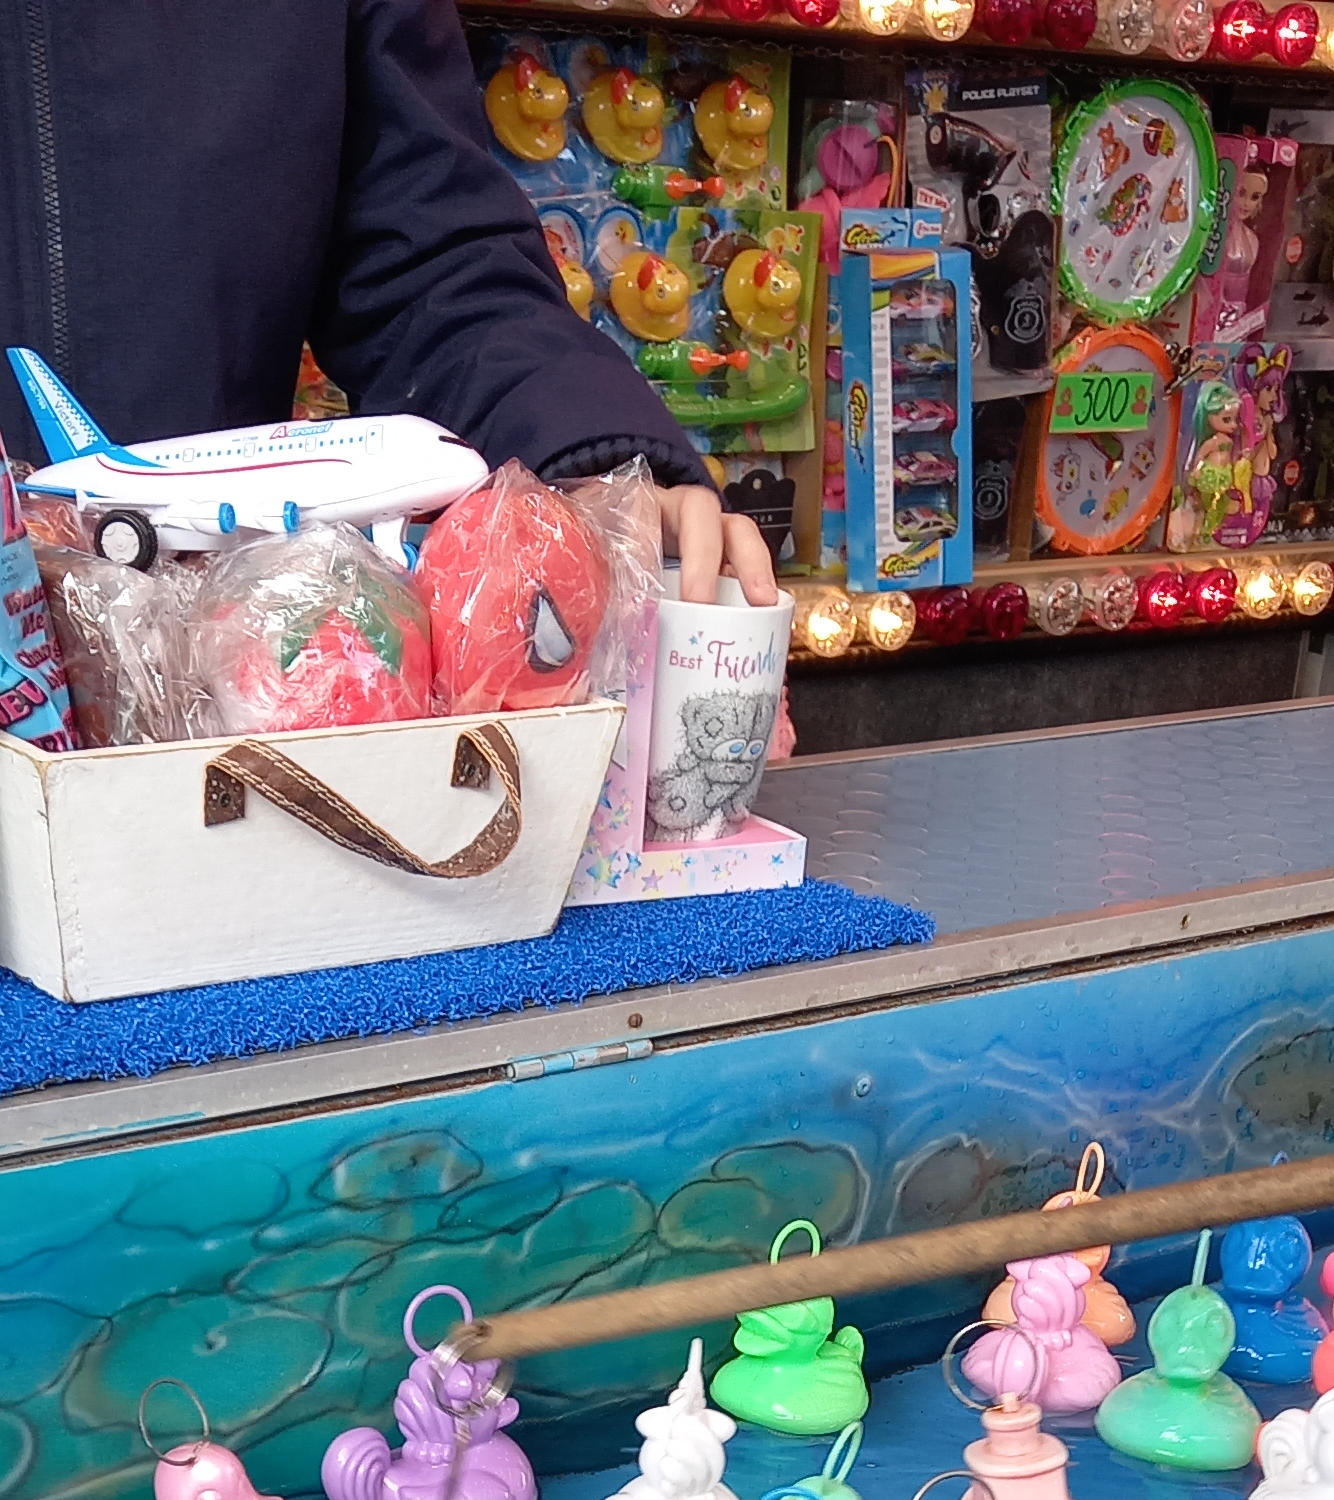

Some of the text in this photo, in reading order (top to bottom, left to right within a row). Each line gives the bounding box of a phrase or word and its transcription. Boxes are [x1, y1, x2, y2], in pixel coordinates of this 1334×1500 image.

[962, 84, 1040, 101] POLICE PLAYSET
[54, 400, 79, 436] Victory
[1074, 376, 1130, 425] 300
[20, 613, 46, 639] Me
[668, 630, 776, 683] BEST Friends
